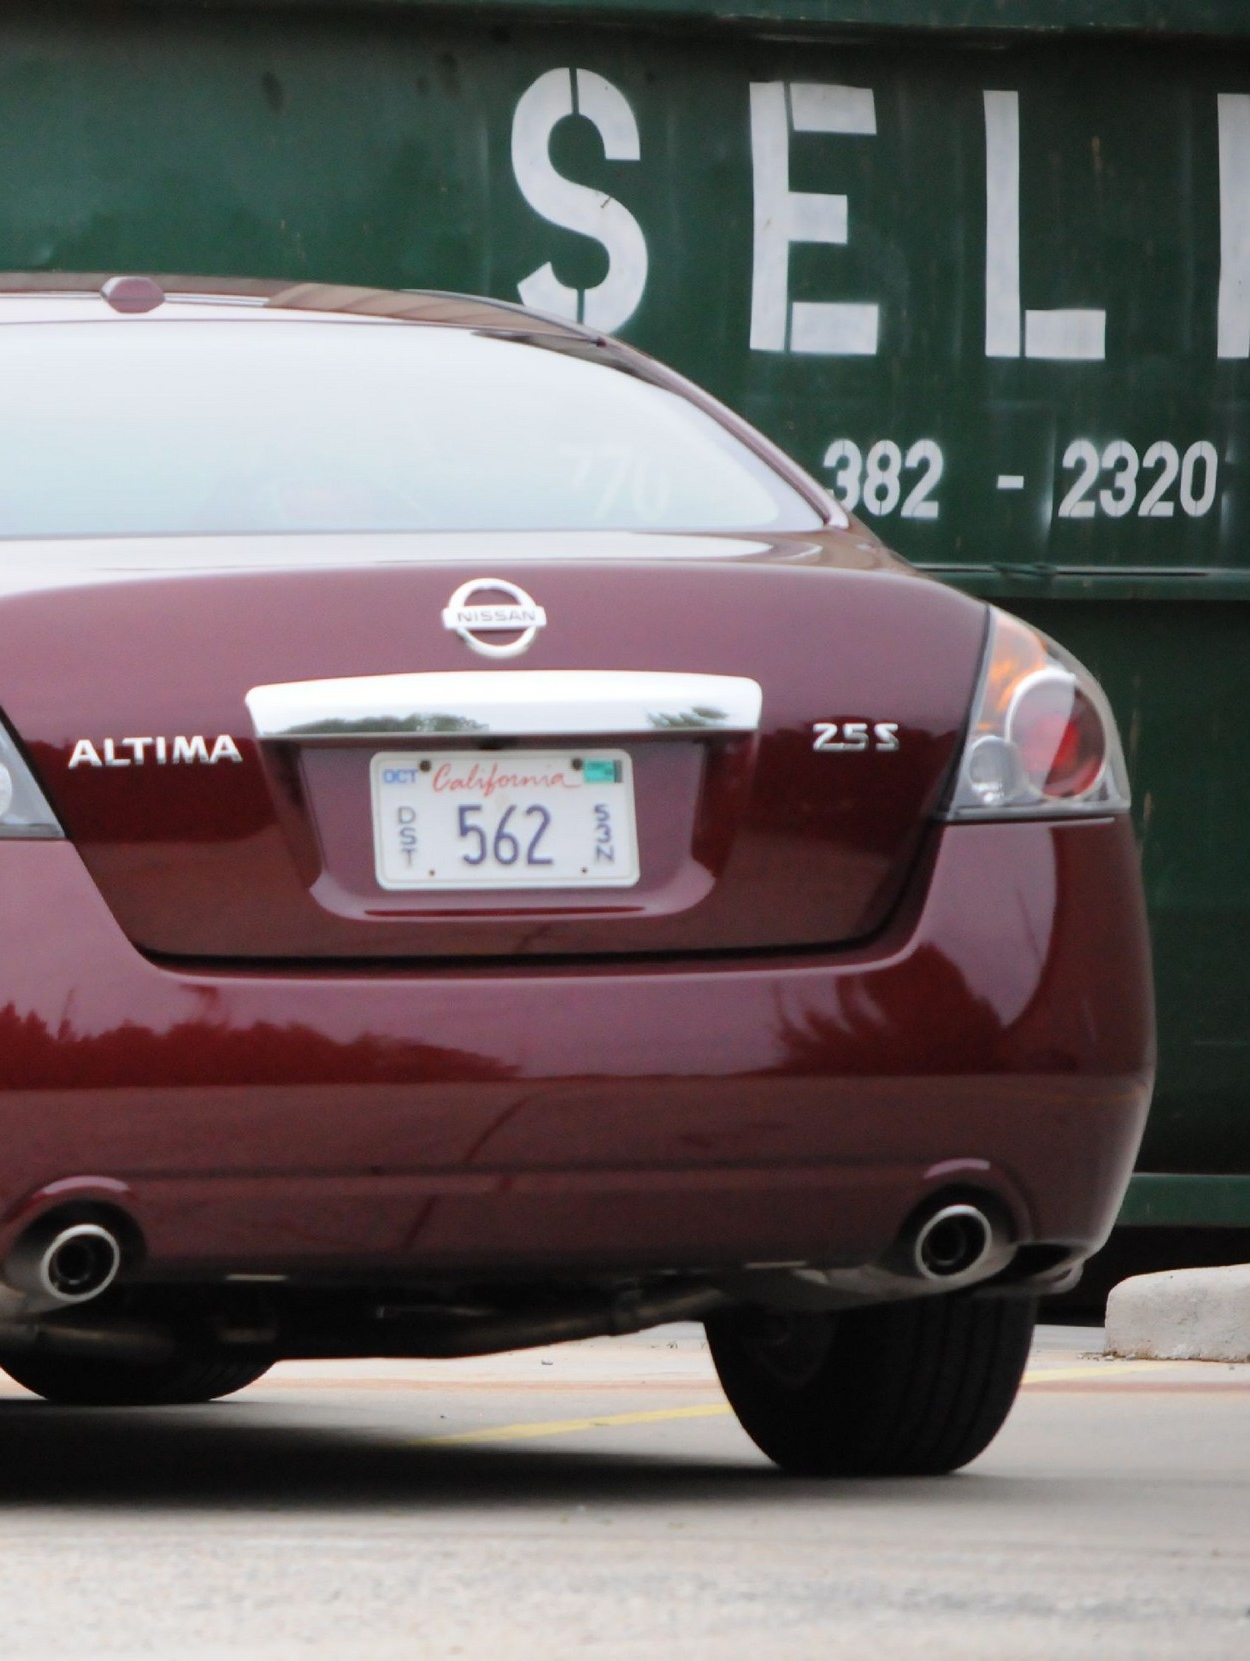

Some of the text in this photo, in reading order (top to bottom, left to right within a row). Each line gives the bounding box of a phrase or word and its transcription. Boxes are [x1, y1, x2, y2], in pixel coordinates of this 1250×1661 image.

[511, 67, 1250, 360] SEL
[823, 439, 944, 519] 382
[1058, 440, 1218, 518] 2320
[457, 610, 536, 622] NISSAN
[68, 734, 243, 768] ALTIMA
[383, 768, 419, 784] OCT
[432, 763, 581, 797] California
[457, 804, 554, 866] 562
